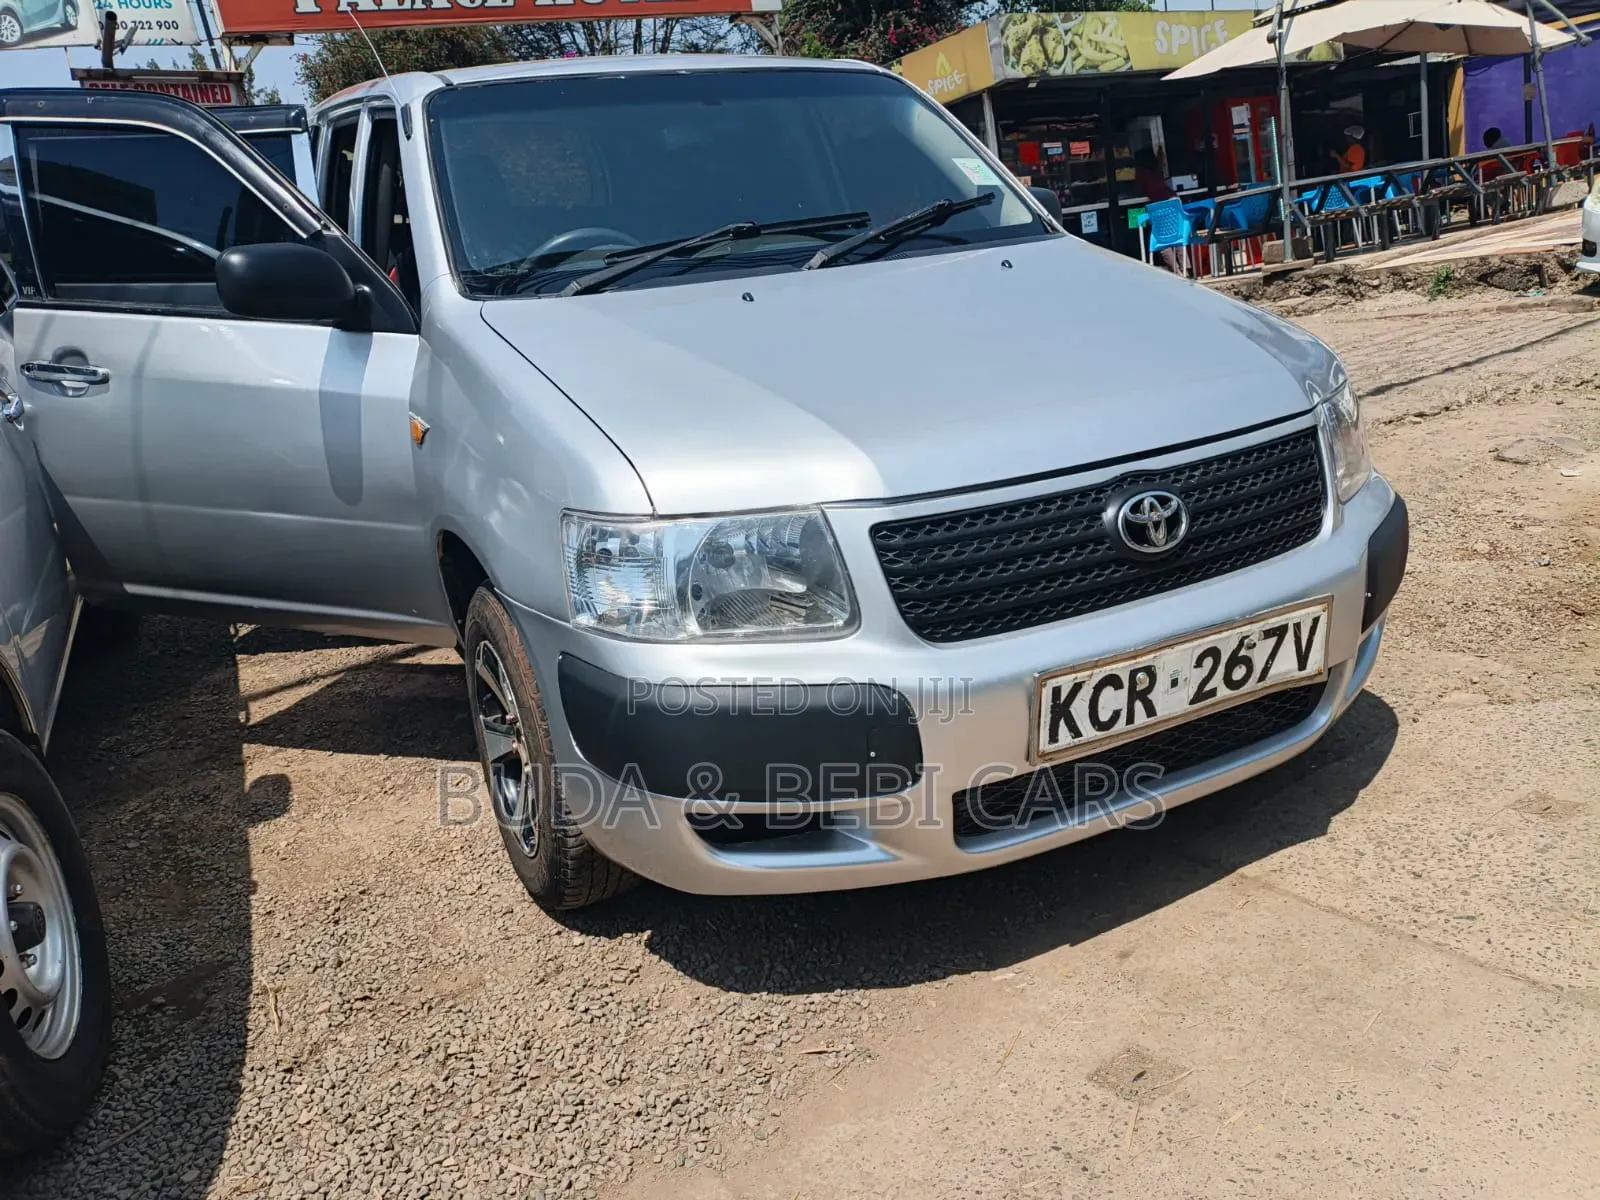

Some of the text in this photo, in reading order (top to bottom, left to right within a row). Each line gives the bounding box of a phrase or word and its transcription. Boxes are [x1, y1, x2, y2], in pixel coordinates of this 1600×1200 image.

[119, 0, 173, 9] HOURS
[156, 20, 179, 30] 900
[1154, 19, 1228, 58] SPICE
[927, 68, 964, 95] SPICE
[1047, 615, 1322, 745] KCR 267V
